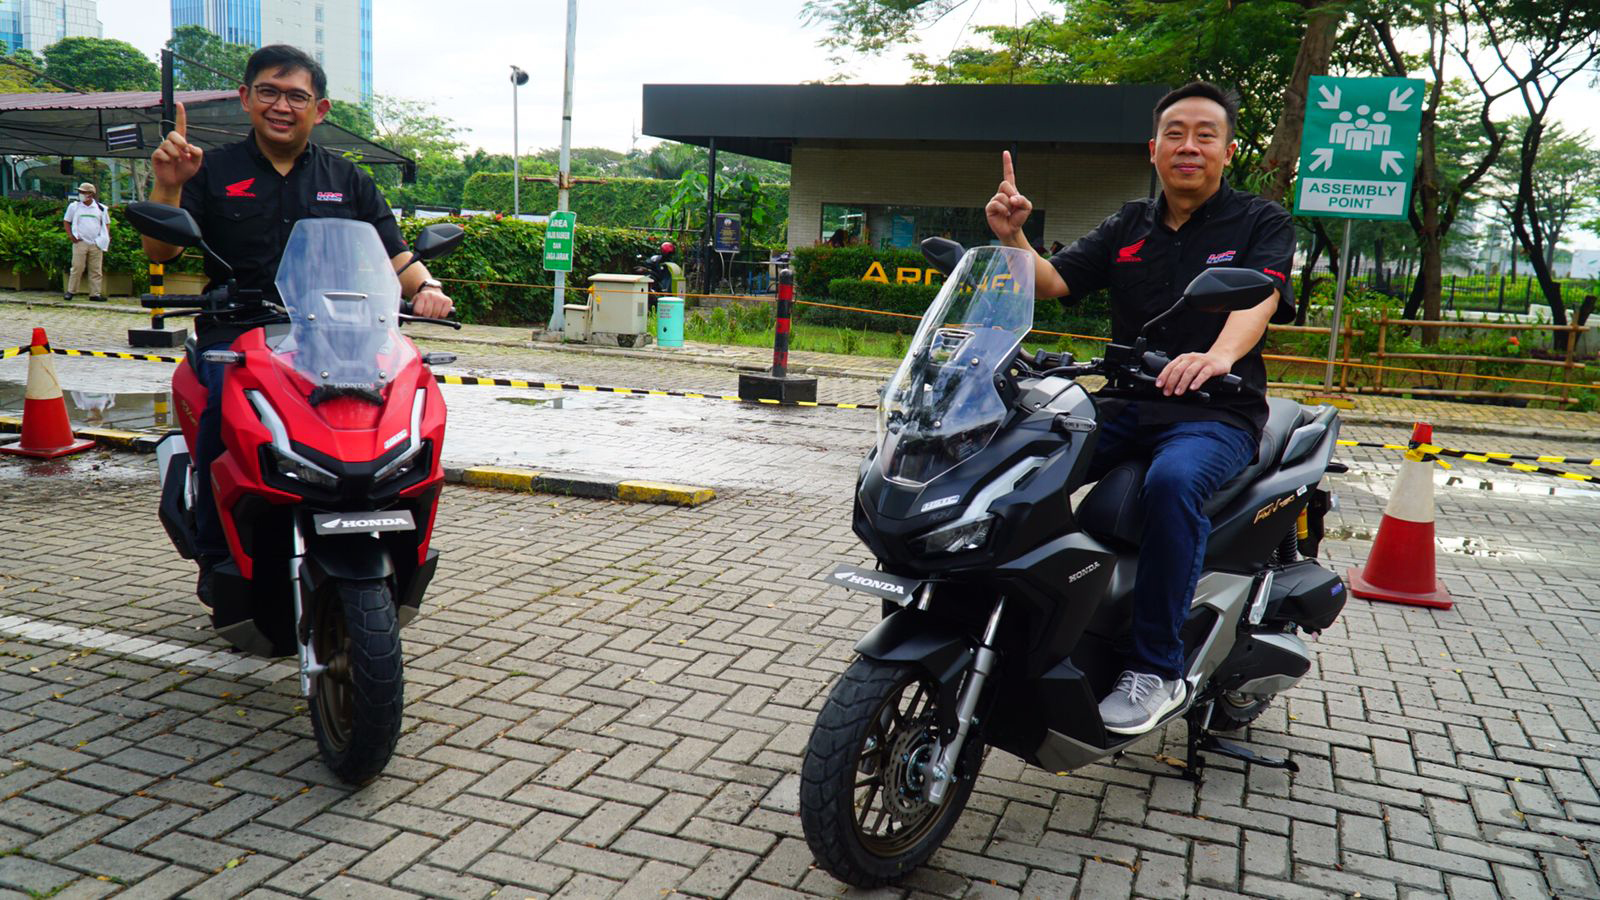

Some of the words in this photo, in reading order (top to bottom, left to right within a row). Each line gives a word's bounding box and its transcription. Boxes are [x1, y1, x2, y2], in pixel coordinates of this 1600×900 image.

[1309, 183, 1397, 197] ASSEMBLY
[1328, 197, 1374, 209] POINT
[551, 220, 567, 228] AREA
[340, 518, 409, 528] HONDA
[1068, 561, 1101, 584] HONDA
[847, 575, 905, 595] HONDA
